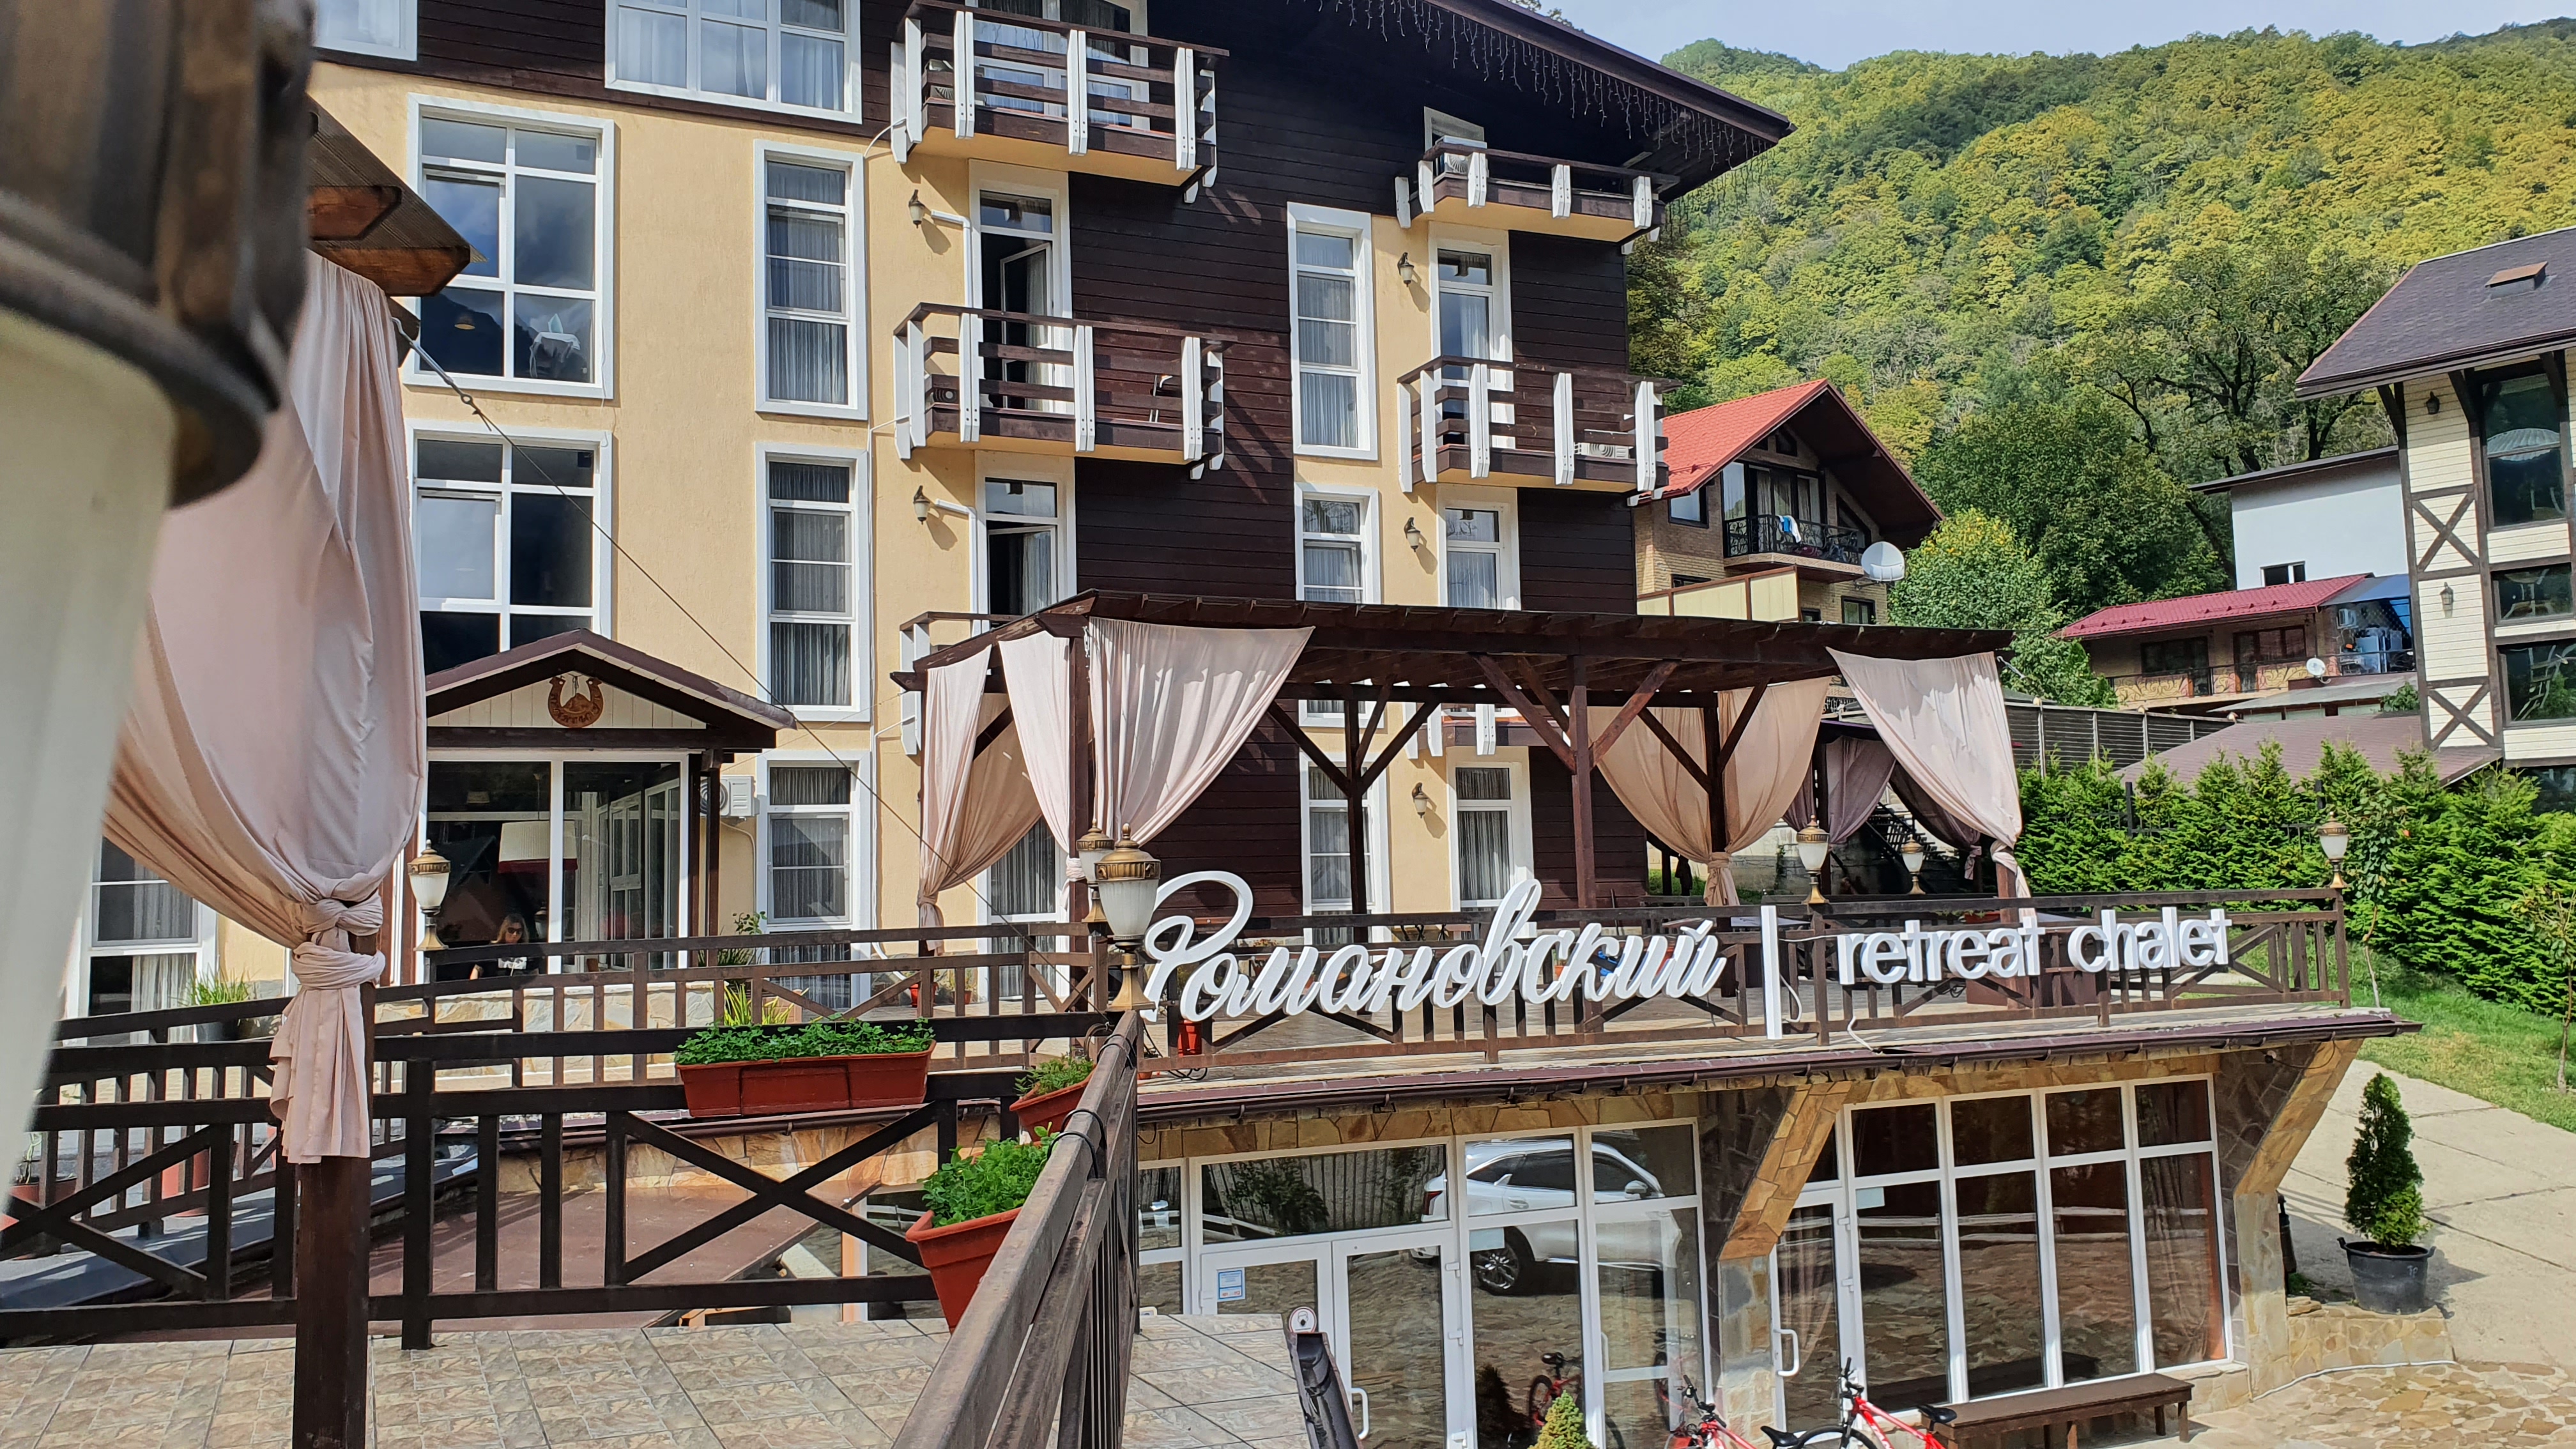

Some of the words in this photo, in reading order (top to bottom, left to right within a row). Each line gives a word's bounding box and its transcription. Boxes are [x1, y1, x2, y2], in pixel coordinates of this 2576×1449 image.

[1139, 870, 1727, 1022] Романовский
[1837, 916, 2044, 985] retreat
[2068, 907, 2232, 972] chalet
